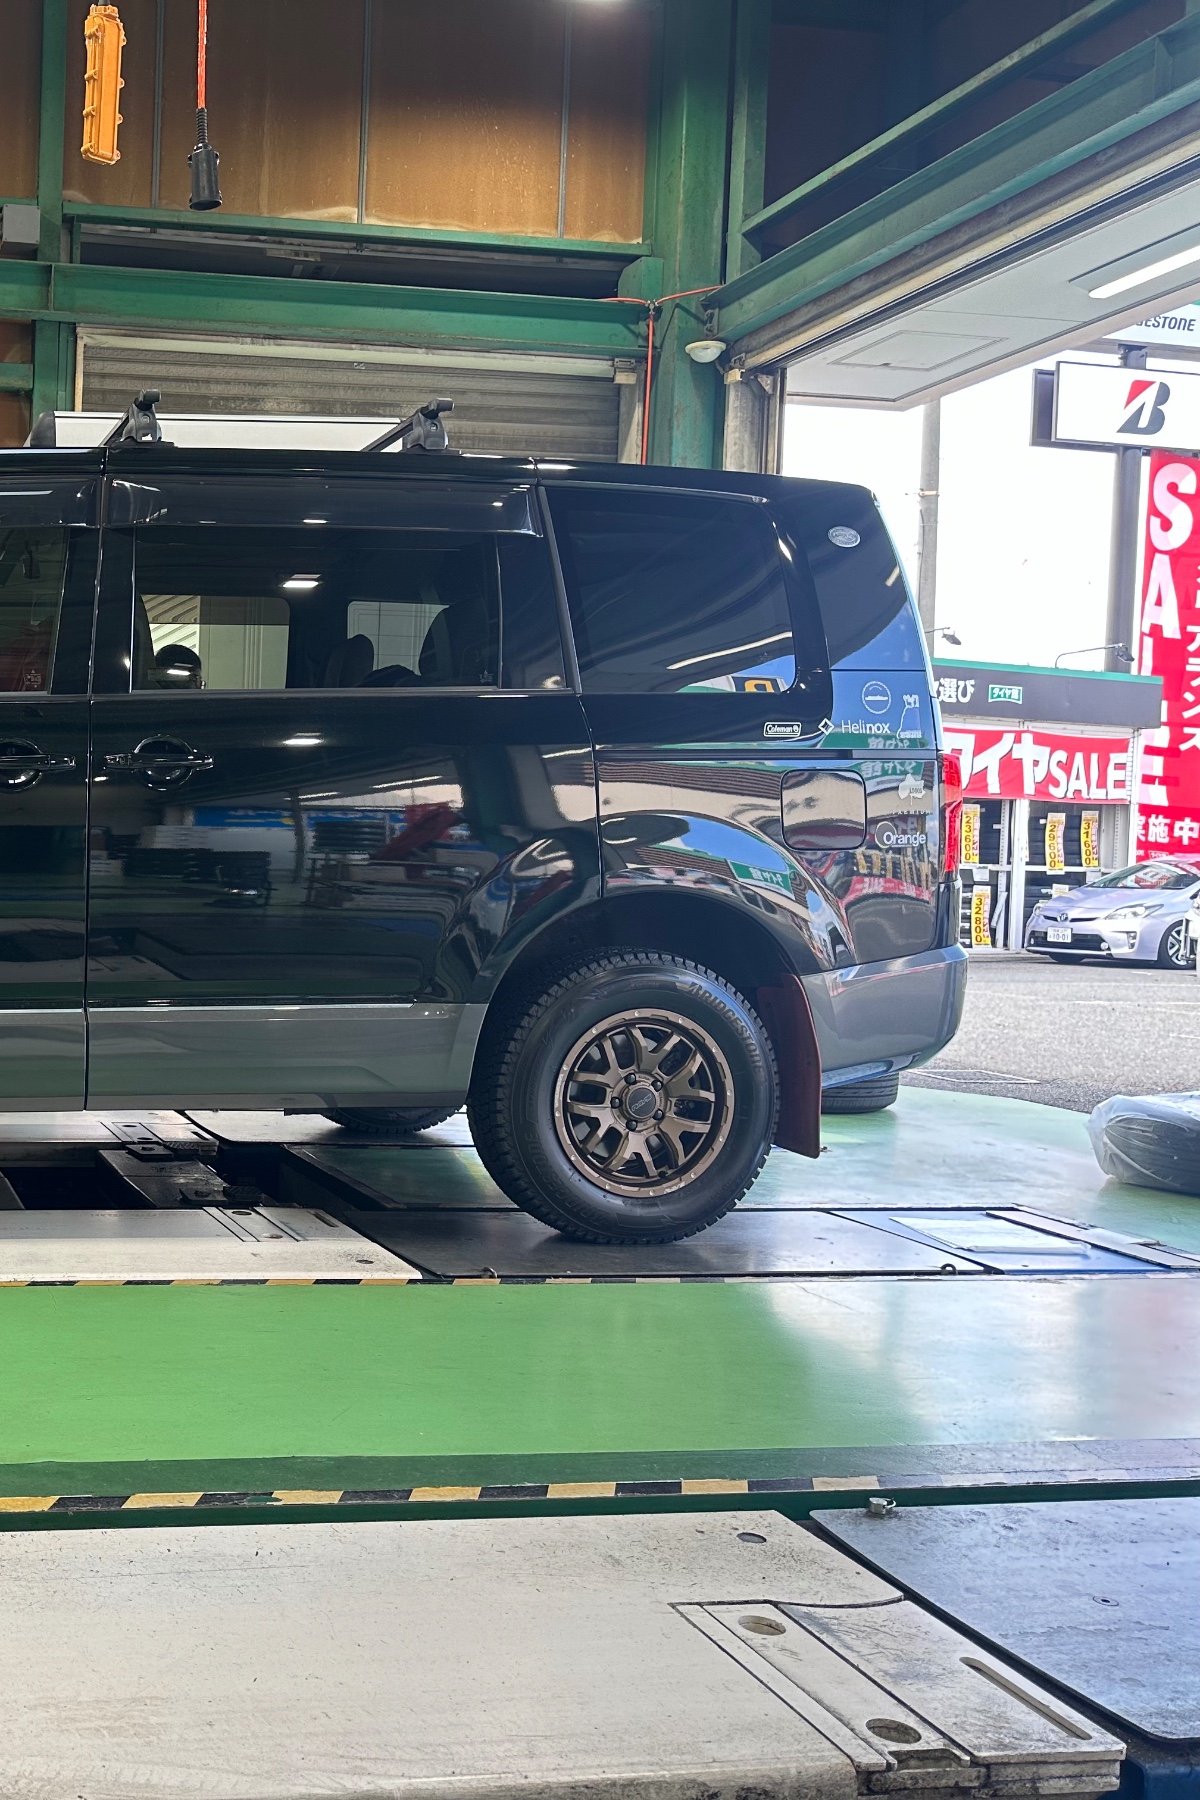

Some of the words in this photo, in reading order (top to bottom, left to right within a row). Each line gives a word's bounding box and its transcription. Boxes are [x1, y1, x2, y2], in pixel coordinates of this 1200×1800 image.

[766, 724, 793, 733] Coleman
[841, 719, 891, 734] Helinox
[882, 831, 927, 847] Orange
[964, 815, 973, 861] 23600
[1048, 824, 1057, 869] 29600
[974, 897, 983, 943] 32800
